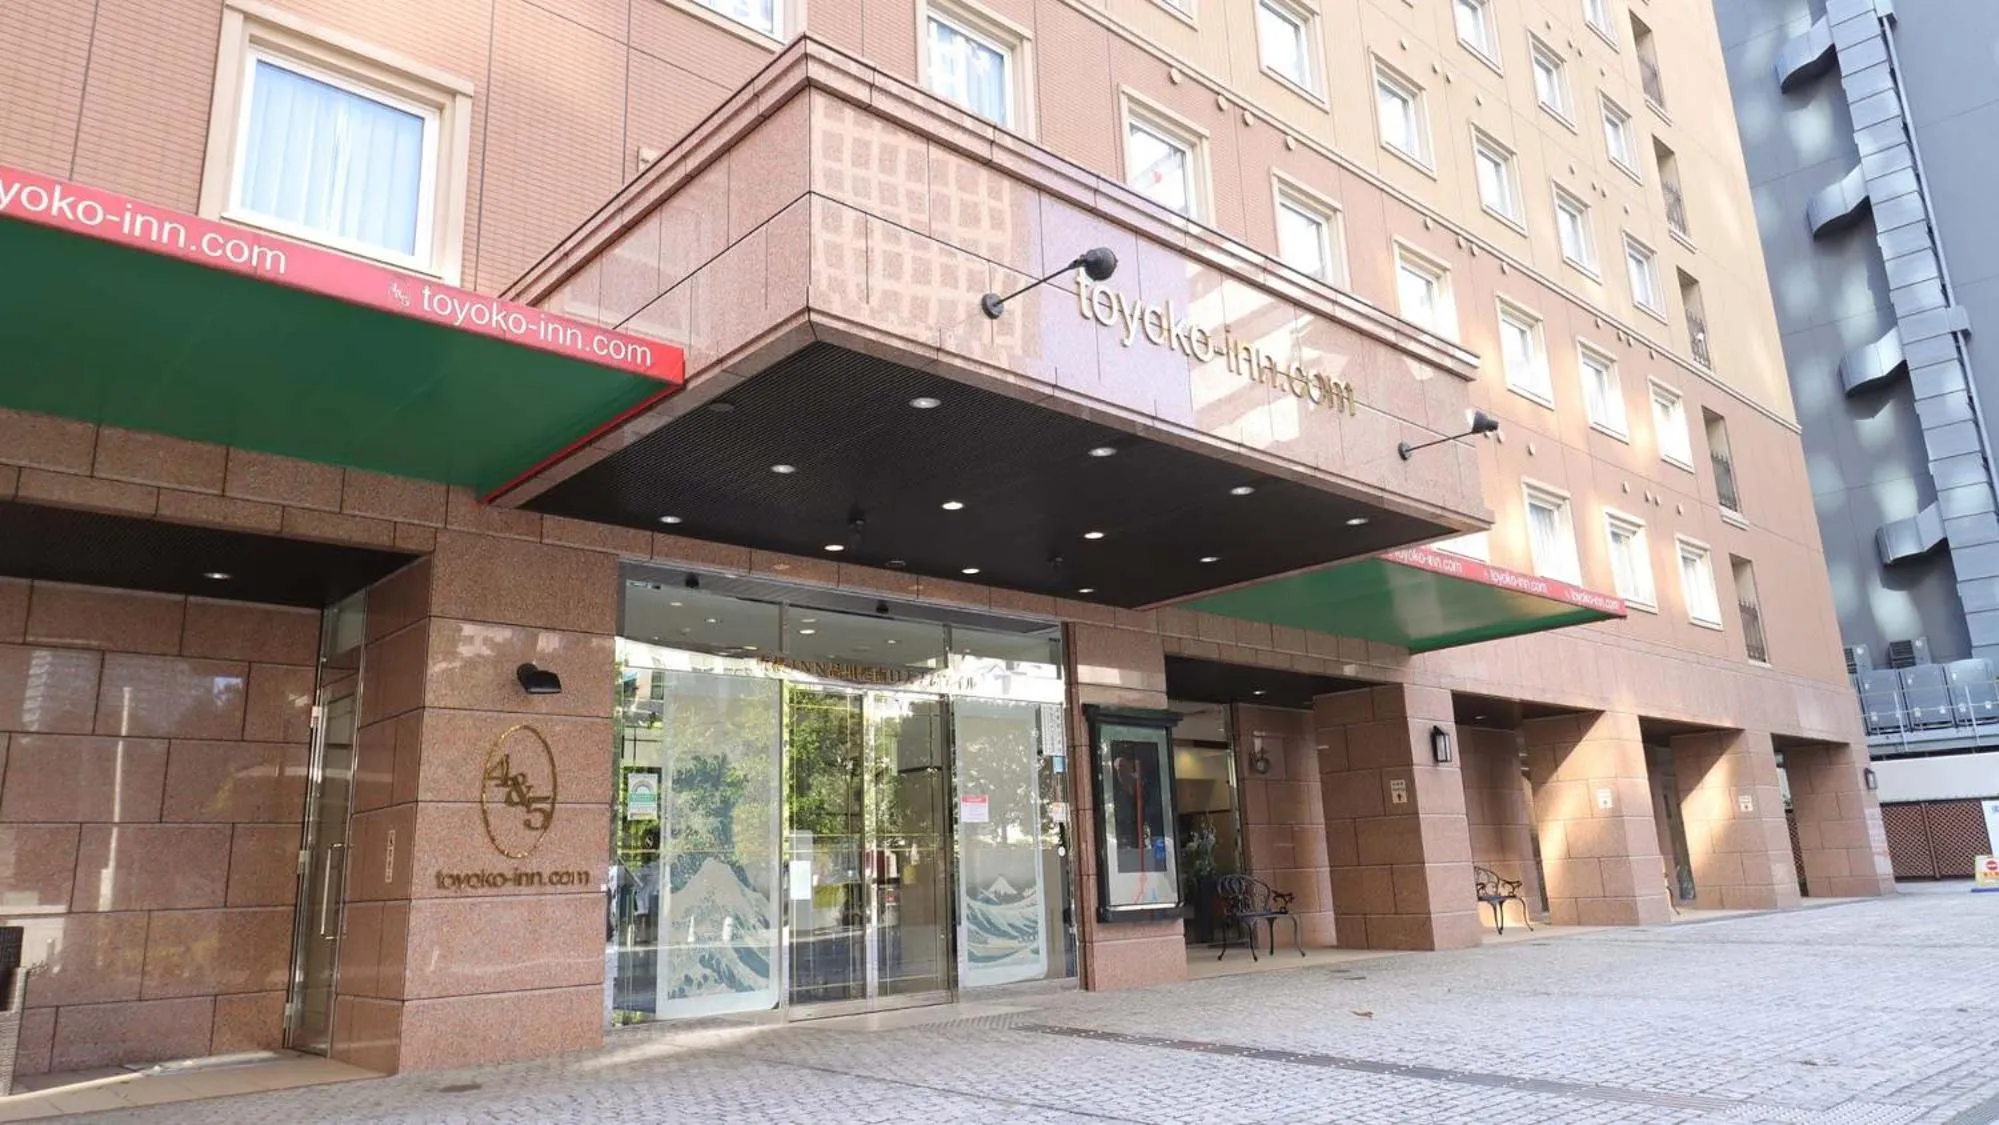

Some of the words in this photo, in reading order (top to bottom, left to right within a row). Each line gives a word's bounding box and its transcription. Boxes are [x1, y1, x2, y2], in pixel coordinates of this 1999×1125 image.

[421, 285, 652, 368] toyoko-inn.com
[1074, 267, 1357, 417] toyoko-inn.com
[435, 868, 590, 890] toyoko-inn.com
